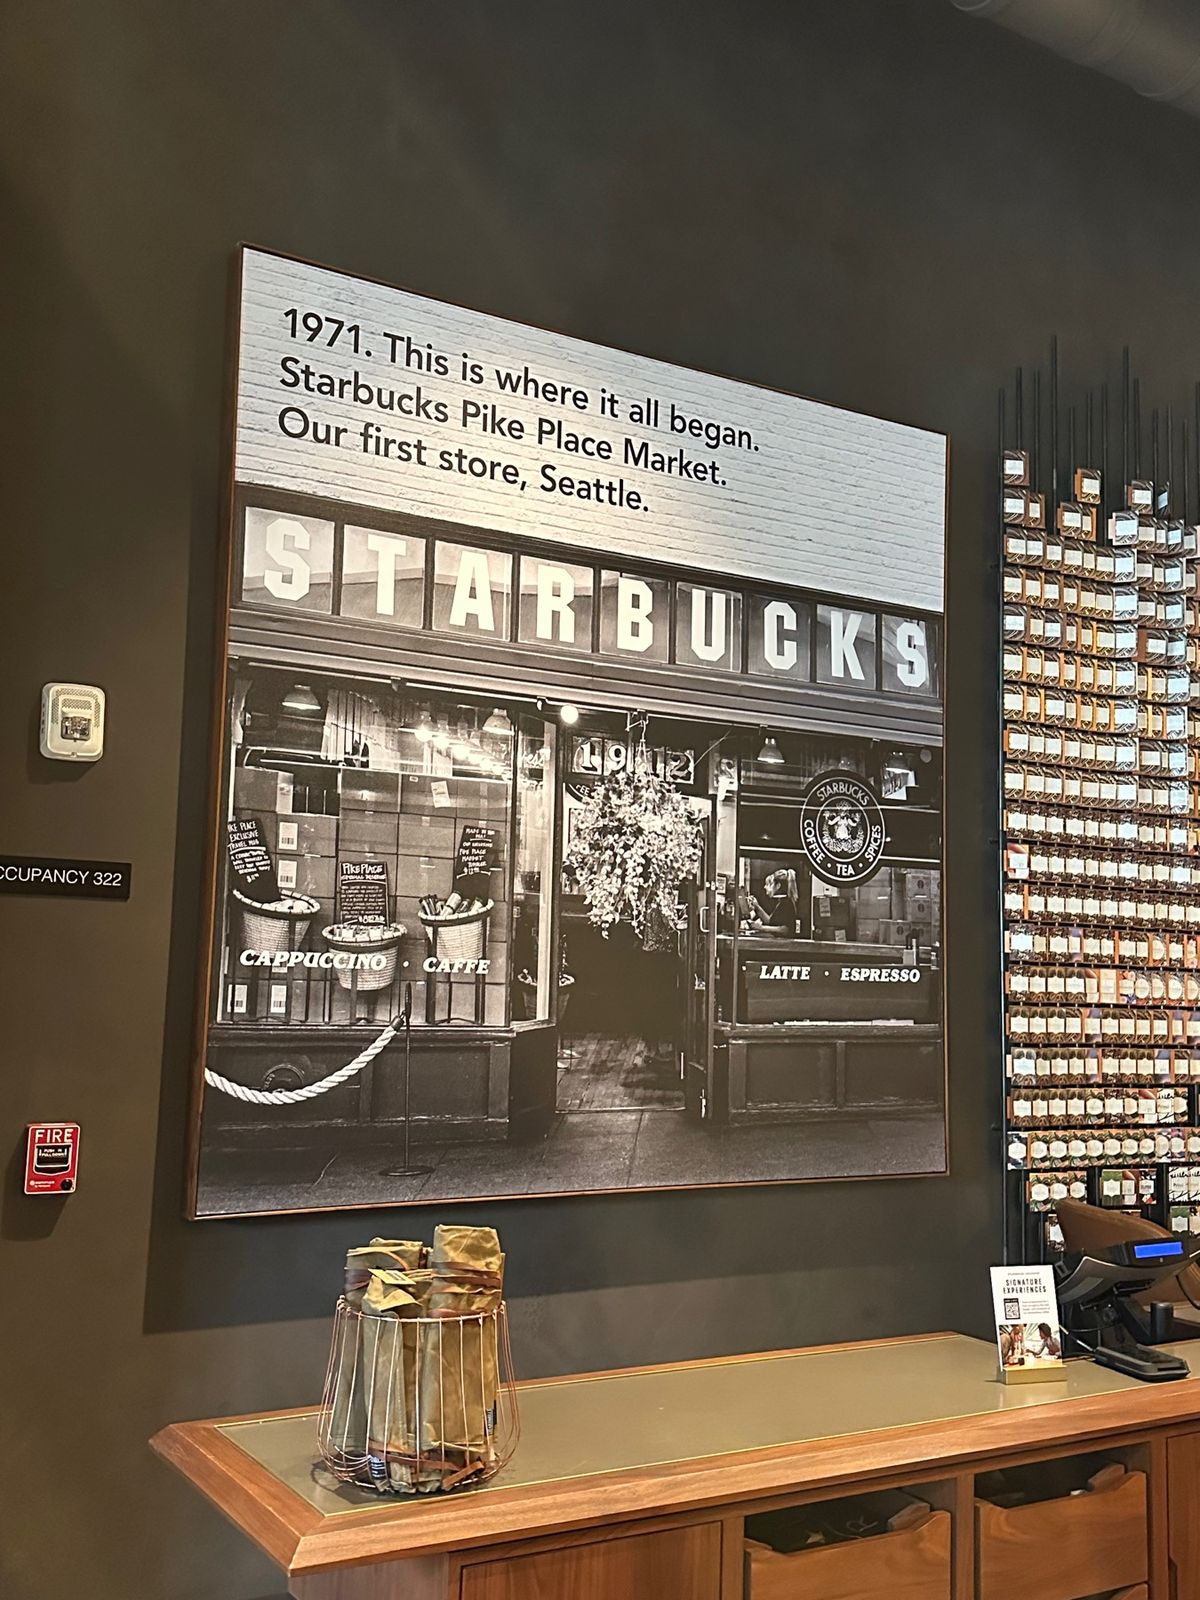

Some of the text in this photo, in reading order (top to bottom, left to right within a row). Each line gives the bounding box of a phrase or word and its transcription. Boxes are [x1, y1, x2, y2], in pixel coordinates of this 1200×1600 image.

[283, 308, 760, 453] 1971. This is where it all began.
[279, 356, 728, 486] Starbucks Pike Place Market.
[278, 406, 650, 513] Our first store, Seattle.
[263, 518, 927, 689] STARBUCKS
[816, 782, 870, 806] STARBUCKS
[804, 819, 826, 864] COFFEE
[864, 825, 881, 862] SPICES
[93, 871, 122, 887] 322
[342, 863, 361, 875] PIKE
[836, 863, 856, 876] TEA
[239, 948, 491, 975] CAPPUCCINO CAFFE
[760, 965, 921, 983] LATTE ESPRESSO
[34, 1128, 74, 1144] FIRE
[1003, 1286, 1046, 1294] EXPERIENCES
[1005, 1278, 1042, 1286] SIGNATURE
